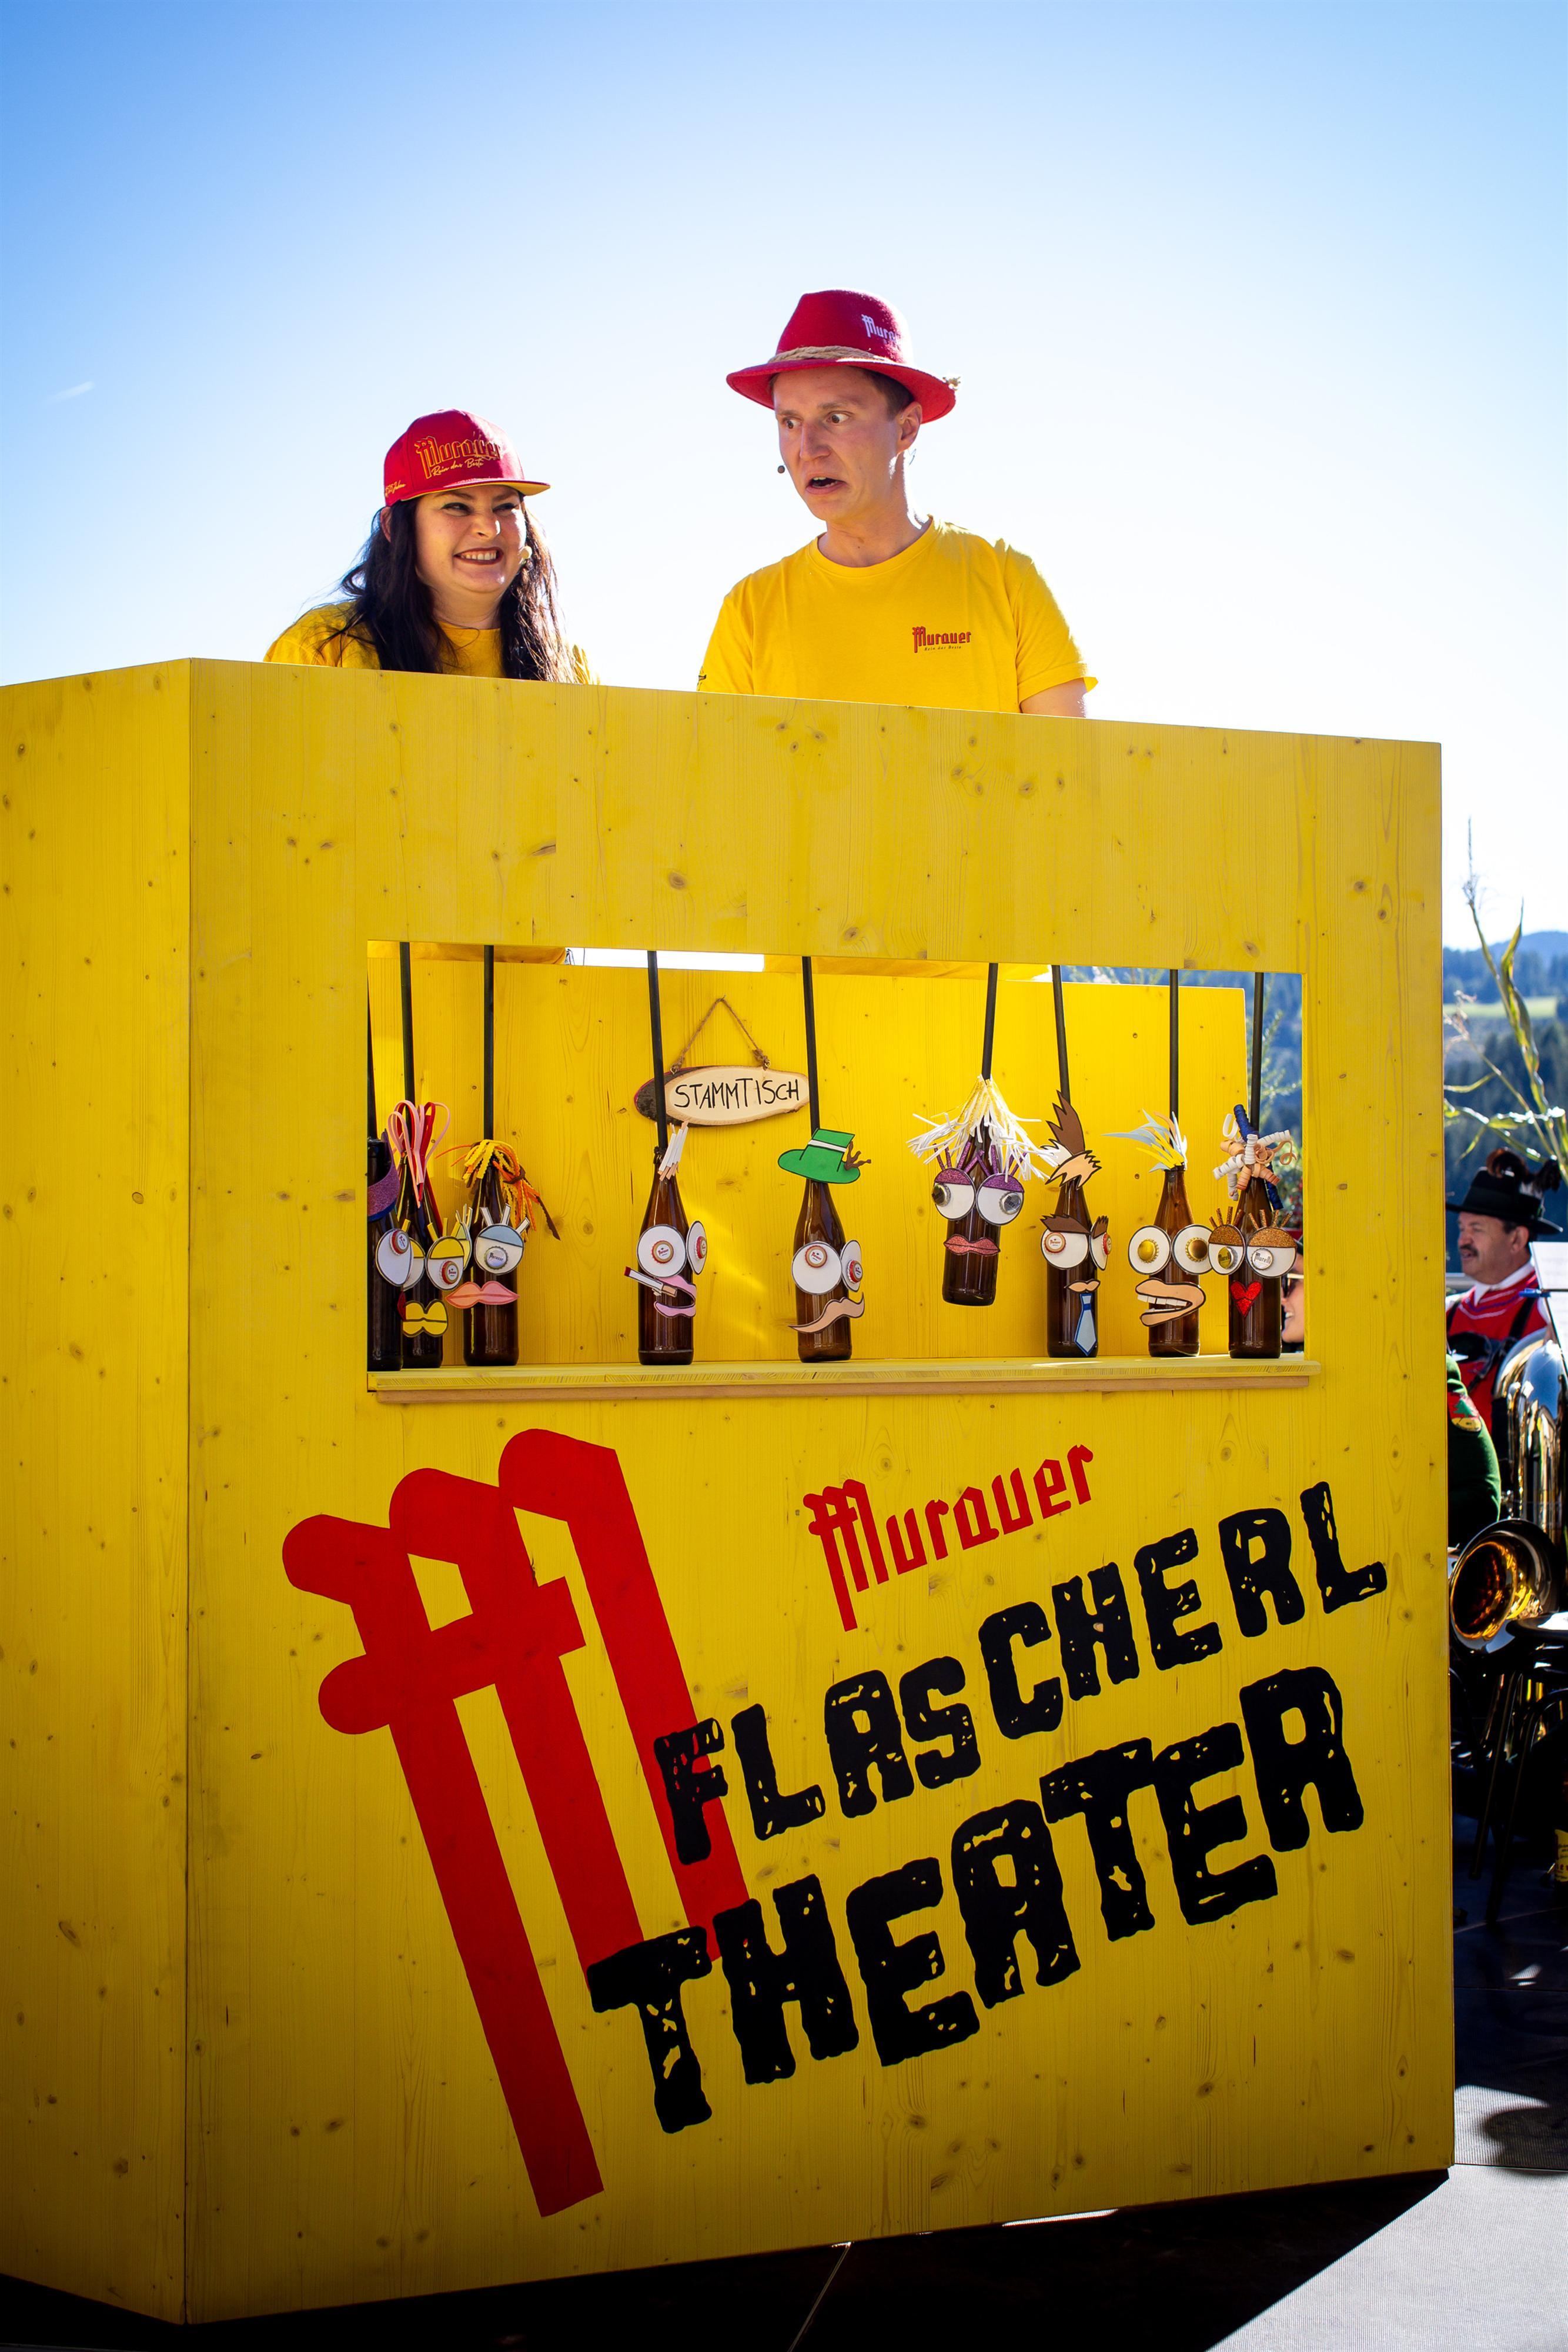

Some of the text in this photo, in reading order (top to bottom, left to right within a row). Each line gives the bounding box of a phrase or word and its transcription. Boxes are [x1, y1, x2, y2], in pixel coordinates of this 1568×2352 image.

[464, 457, 484, 468] Beste
[912, 626, 971, 653] Murauer
[674, 1077, 800, 1110] STAMMTISCH
[803, 1444, 1094, 1632] Murauer
[654, 1482, 1388, 1865] FLASCHERL
[587, 1666, 1364, 2134] THEATER
